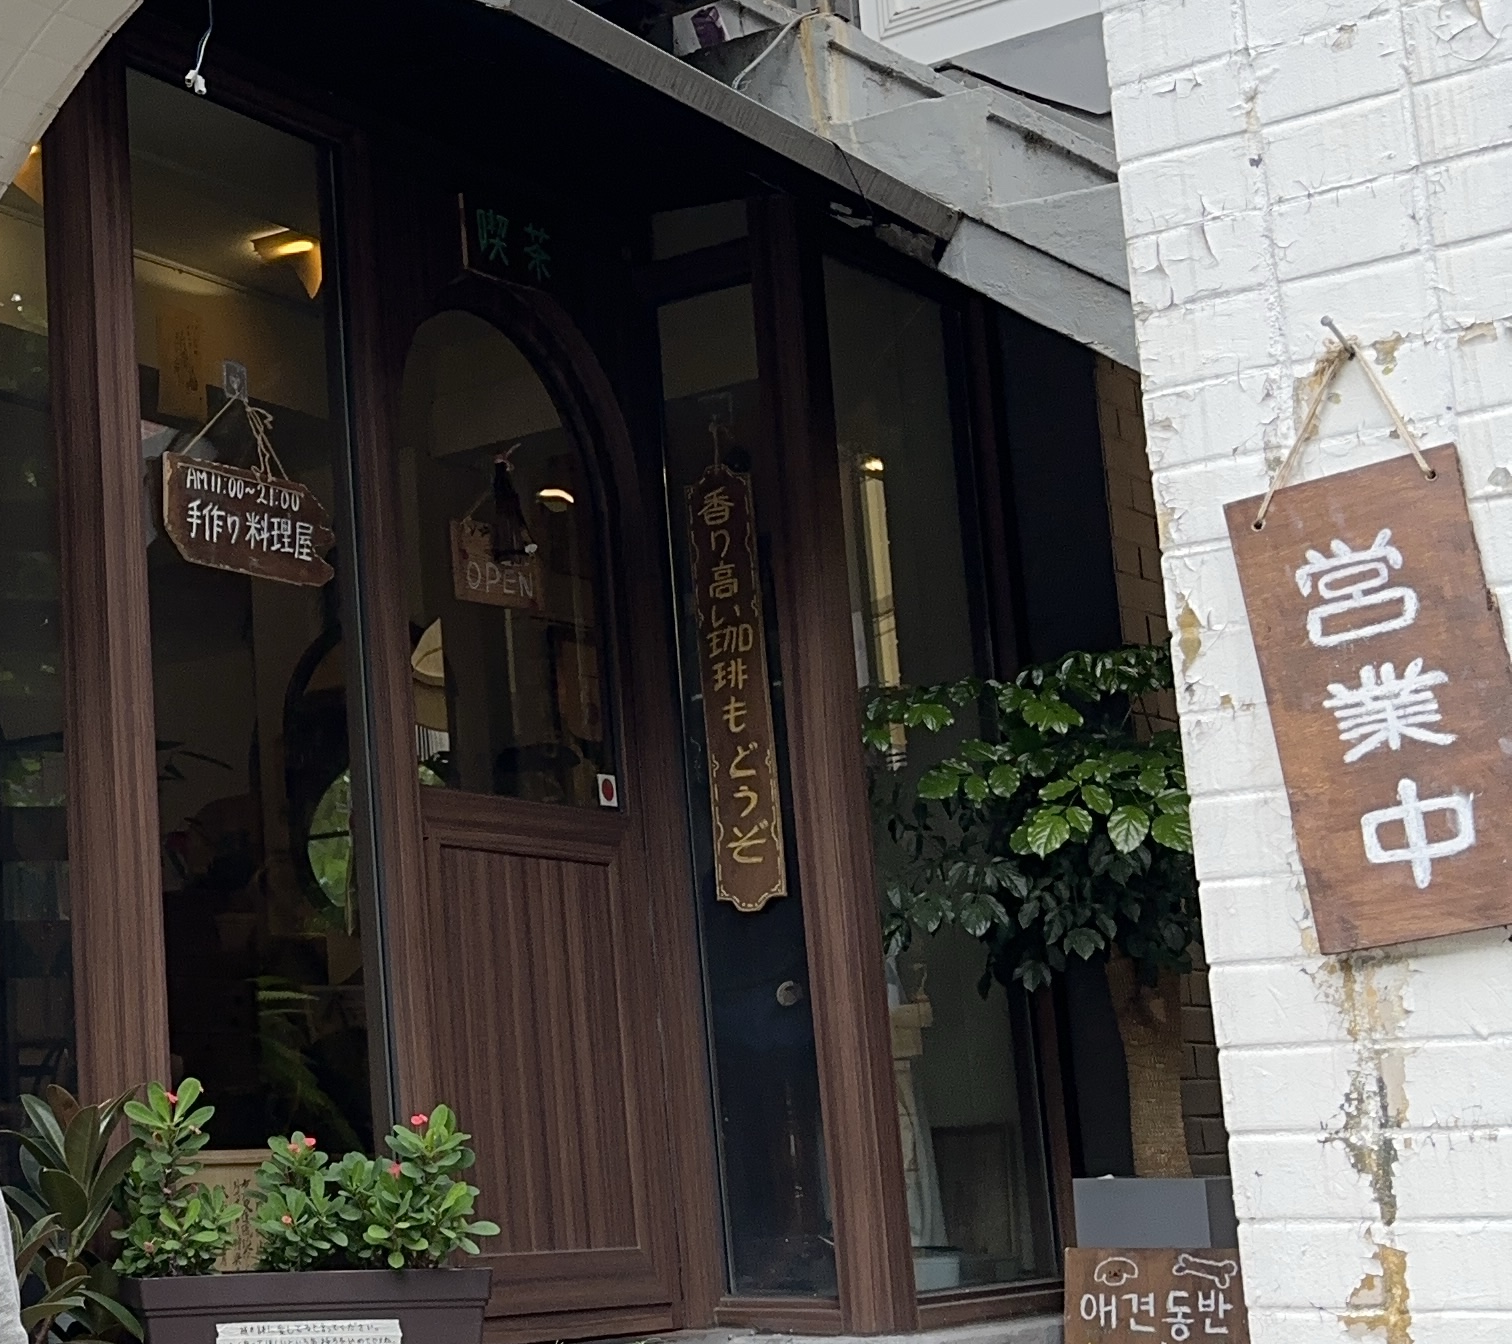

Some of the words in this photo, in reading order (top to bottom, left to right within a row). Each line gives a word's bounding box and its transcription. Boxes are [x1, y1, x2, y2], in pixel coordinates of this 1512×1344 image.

[476, 209, 552, 281] 喫茶
[466, 560, 535, 599] OPEN
[697, 485, 769, 864] 香り高い珈琲もどうぞ
[1295, 528, 1476, 890] 営業中
[1079, 1289, 1234, 1342] 애견동반
